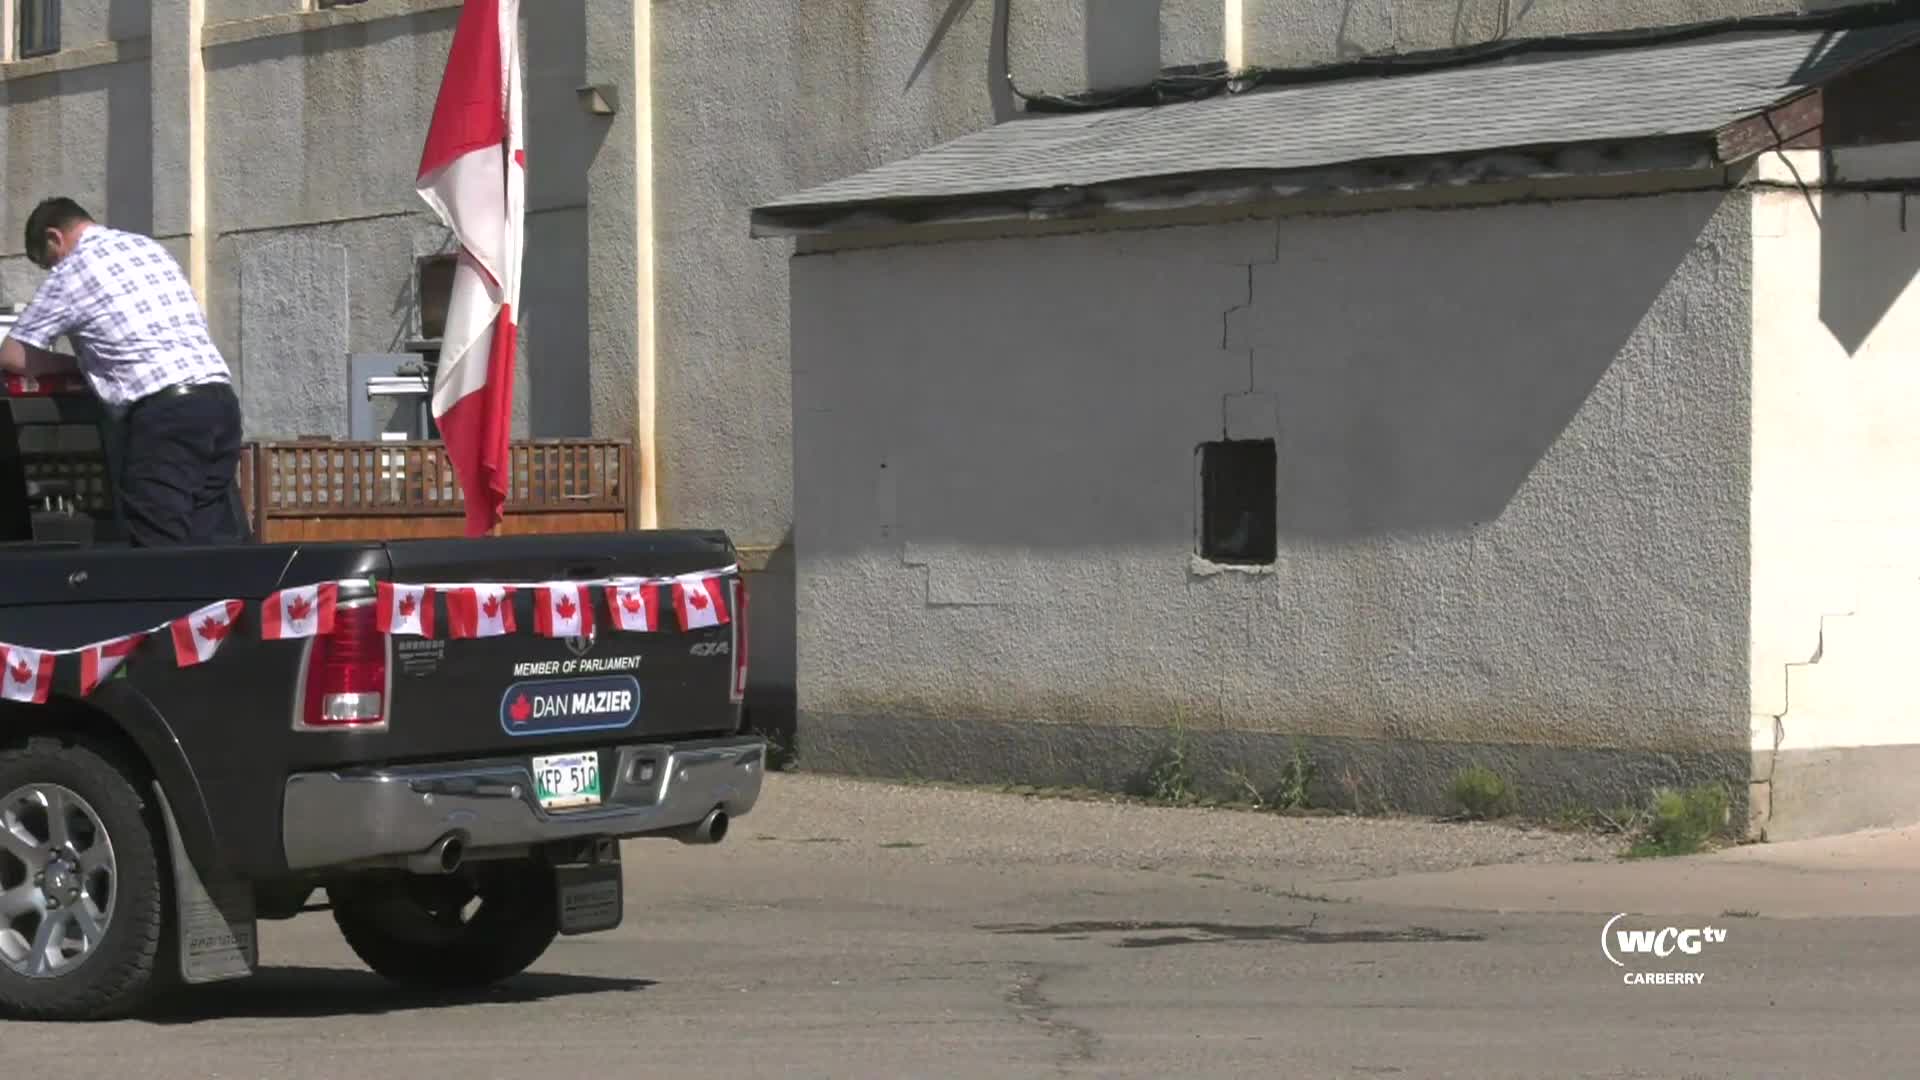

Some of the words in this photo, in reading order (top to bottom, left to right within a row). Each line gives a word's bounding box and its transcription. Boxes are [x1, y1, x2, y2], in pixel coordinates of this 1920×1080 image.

[514, 661, 559, 676] MEMBER
[562, 661, 577, 673] OF
[579, 655, 642, 672] PARLIAMENT
[533, 694, 568, 718] DAN
[572, 690, 632, 714] MAZIER
[537, 768, 562, 795] KFP
[571, 766, 597, 793] 510
